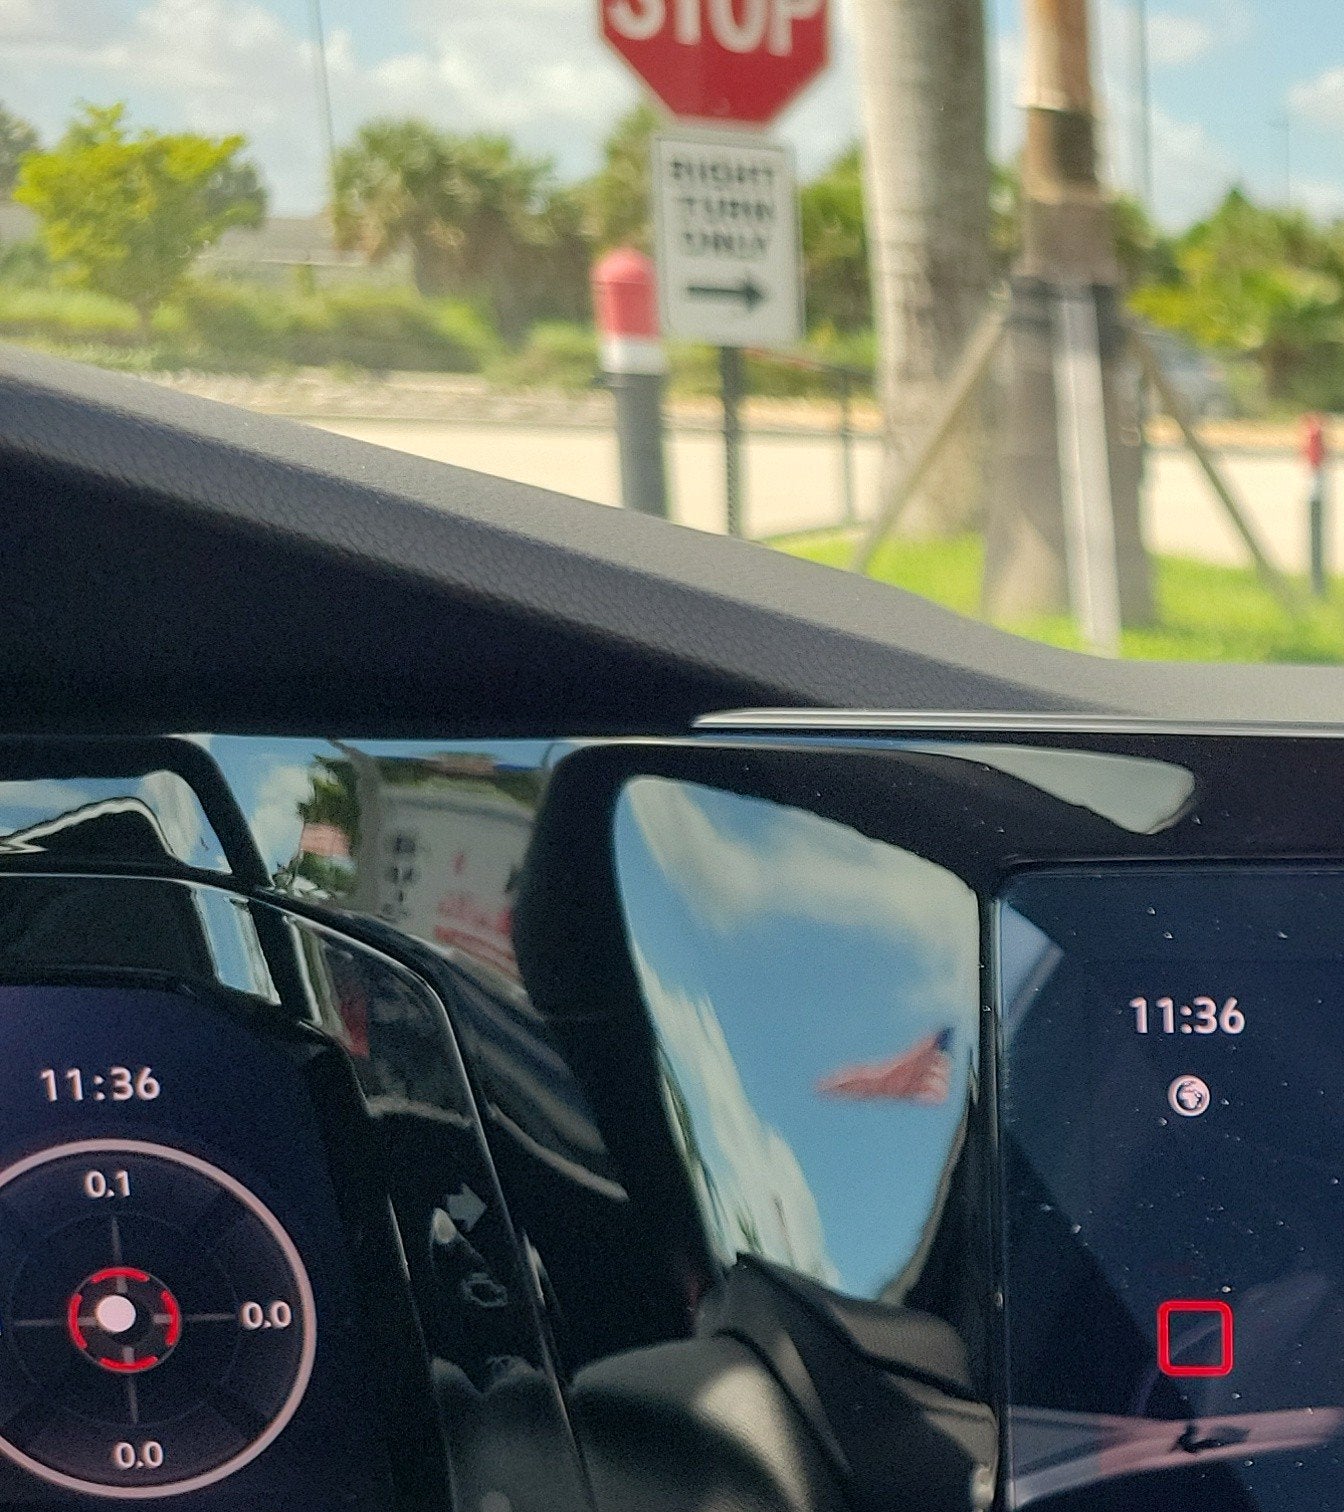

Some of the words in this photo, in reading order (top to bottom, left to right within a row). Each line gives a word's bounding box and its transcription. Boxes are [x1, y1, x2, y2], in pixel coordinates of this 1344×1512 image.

[1131, 996, 1246, 1035] 11:36
[40, 1066, 161, 1102] 11:36
[85, 1170, 131, 1198] 0.1
[241, 1300, 292, 1330] 0.0
[114, 1441, 164, 1469] 0.0
